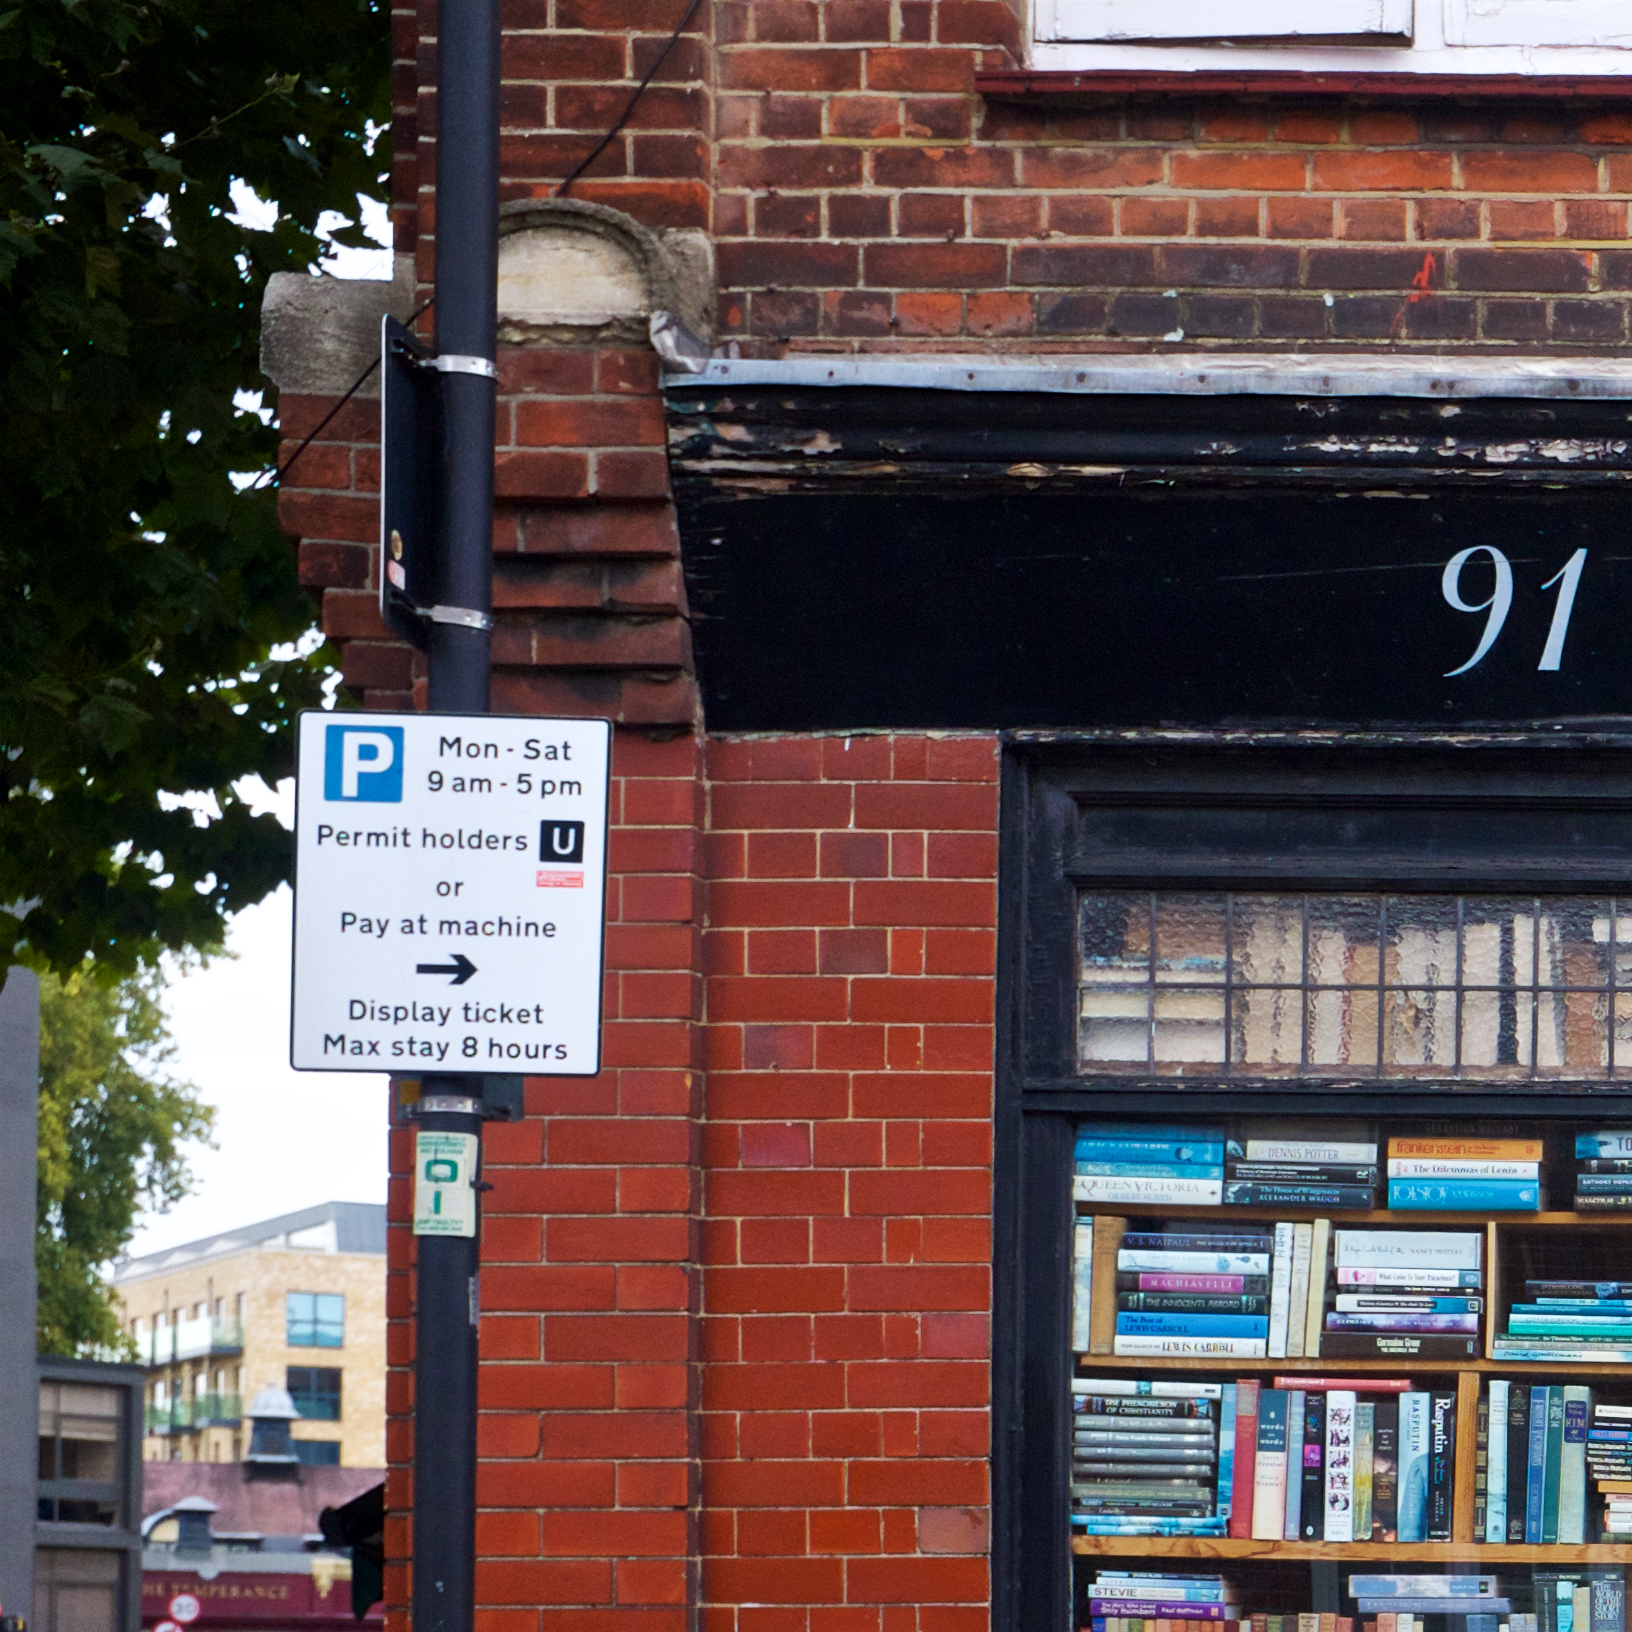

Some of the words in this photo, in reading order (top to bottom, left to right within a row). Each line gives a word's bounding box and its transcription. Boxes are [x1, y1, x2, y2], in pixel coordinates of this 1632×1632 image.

[1441, 545, 1590, 678] 91
[439, 737, 500, 758] Mon
[524, 740, 571, 761] Sat
[342, 732, 394, 797] P
[317, 825, 411, 848] Permit
[421, 828, 527, 851] holders
[553, 827, 576, 854] U
[436, 881, 464, 897] or
[341, 913, 389, 939] Pay
[400, 915, 428, 936] at
[439, 916, 556, 938] machine
[349, 1001, 451, 1026] Display
[463, 1003, 543, 1025] ticket
[324, 1035, 381, 1056] Max
[391, 1037, 450, 1062] stay
[462, 1037, 478, 1058] 8
[489, 1038, 568, 1060] hours
[1267, 1147, 1302, 1160] DENNIS
[1304, 1148, 1340, 1161] POTTER
[1396, 1141, 1466, 1155] frankenstein
[1136, 1179, 1200, 1193] VICTORIA
[1151, 1325, 1190, 1335] CARROLL
[1093, 1587, 1138, 1598] STEVIE
